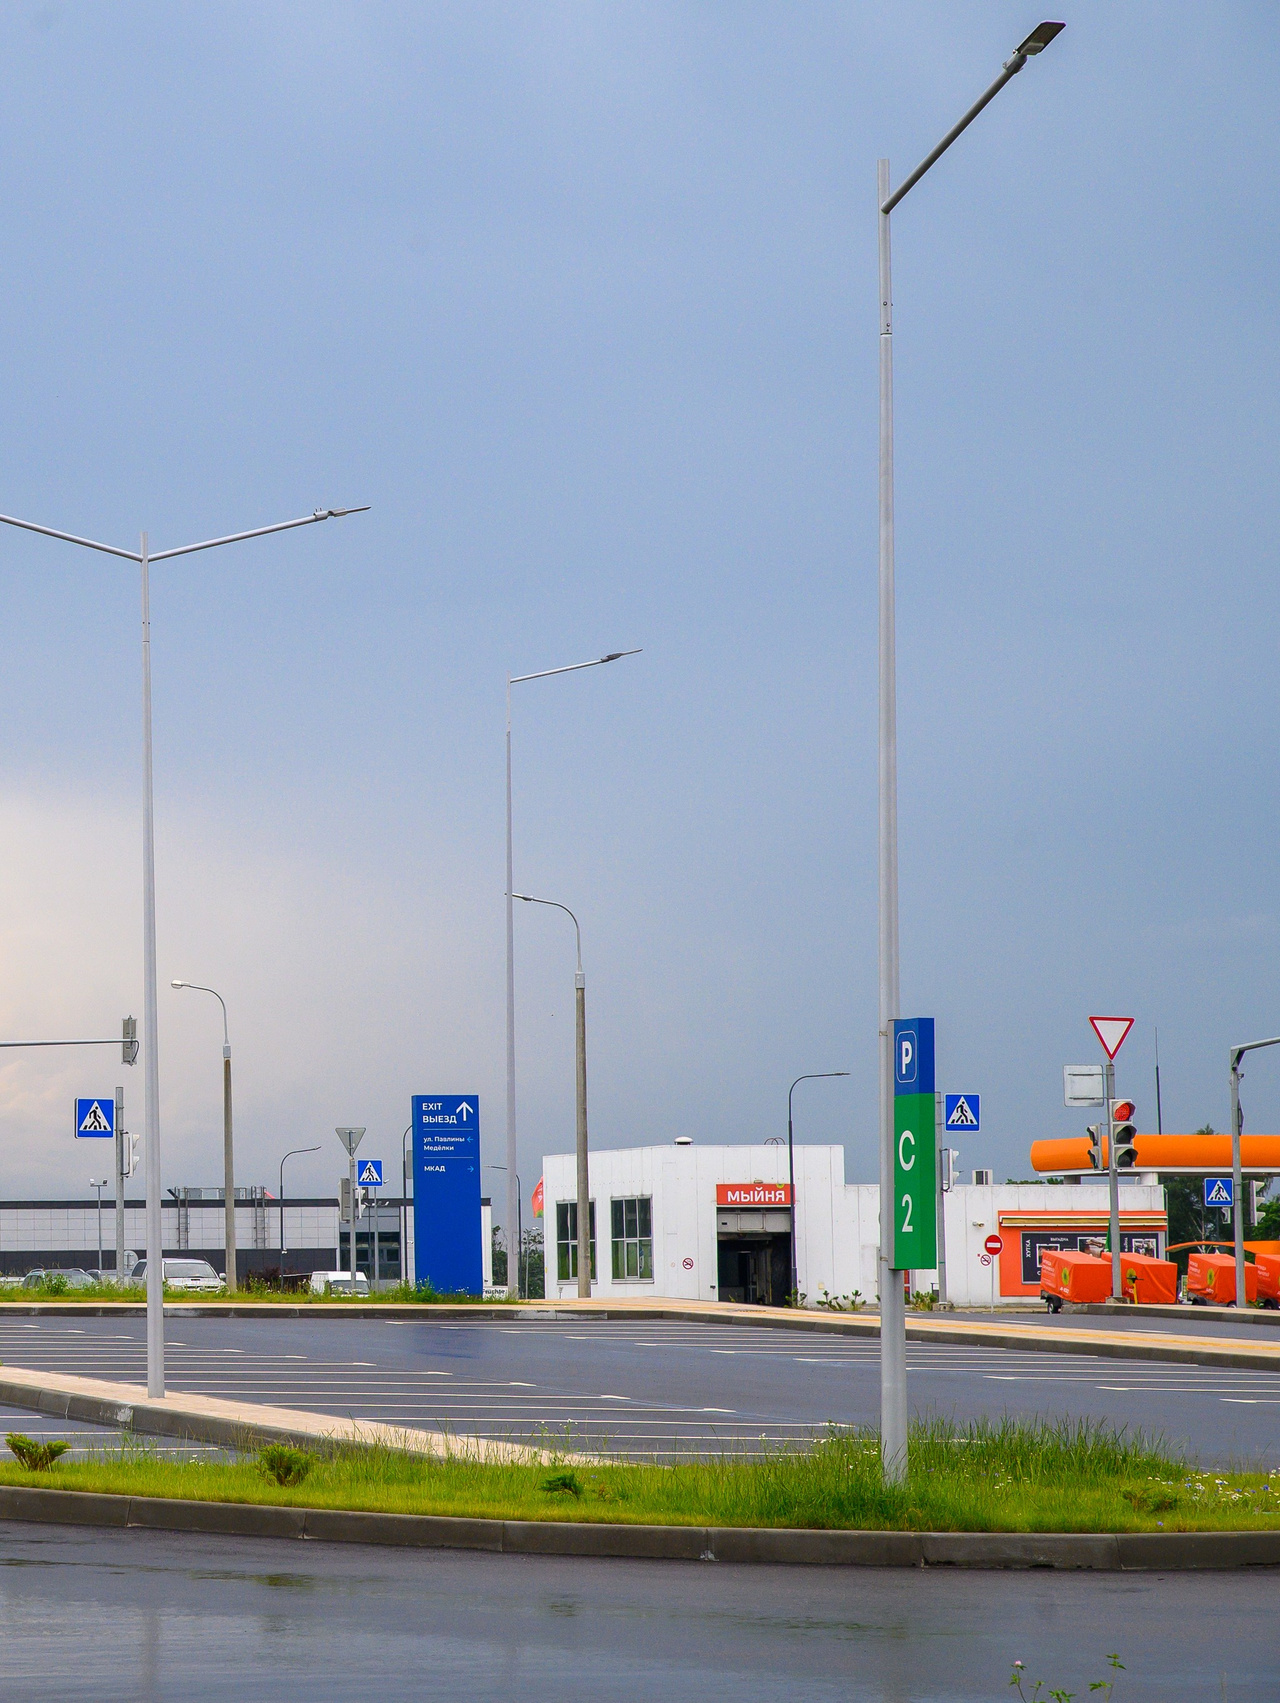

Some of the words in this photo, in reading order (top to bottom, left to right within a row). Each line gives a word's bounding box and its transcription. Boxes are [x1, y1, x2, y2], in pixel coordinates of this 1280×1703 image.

[902, 1041, 913, 1075] P
[422, 1102, 443, 1111] EXIT
[422, 1115, 457, 1124] ВЫЕЗД
[727, 1186, 785, 1202] МЫЙНЯ
[901, 1193, 914, 1233] 2
